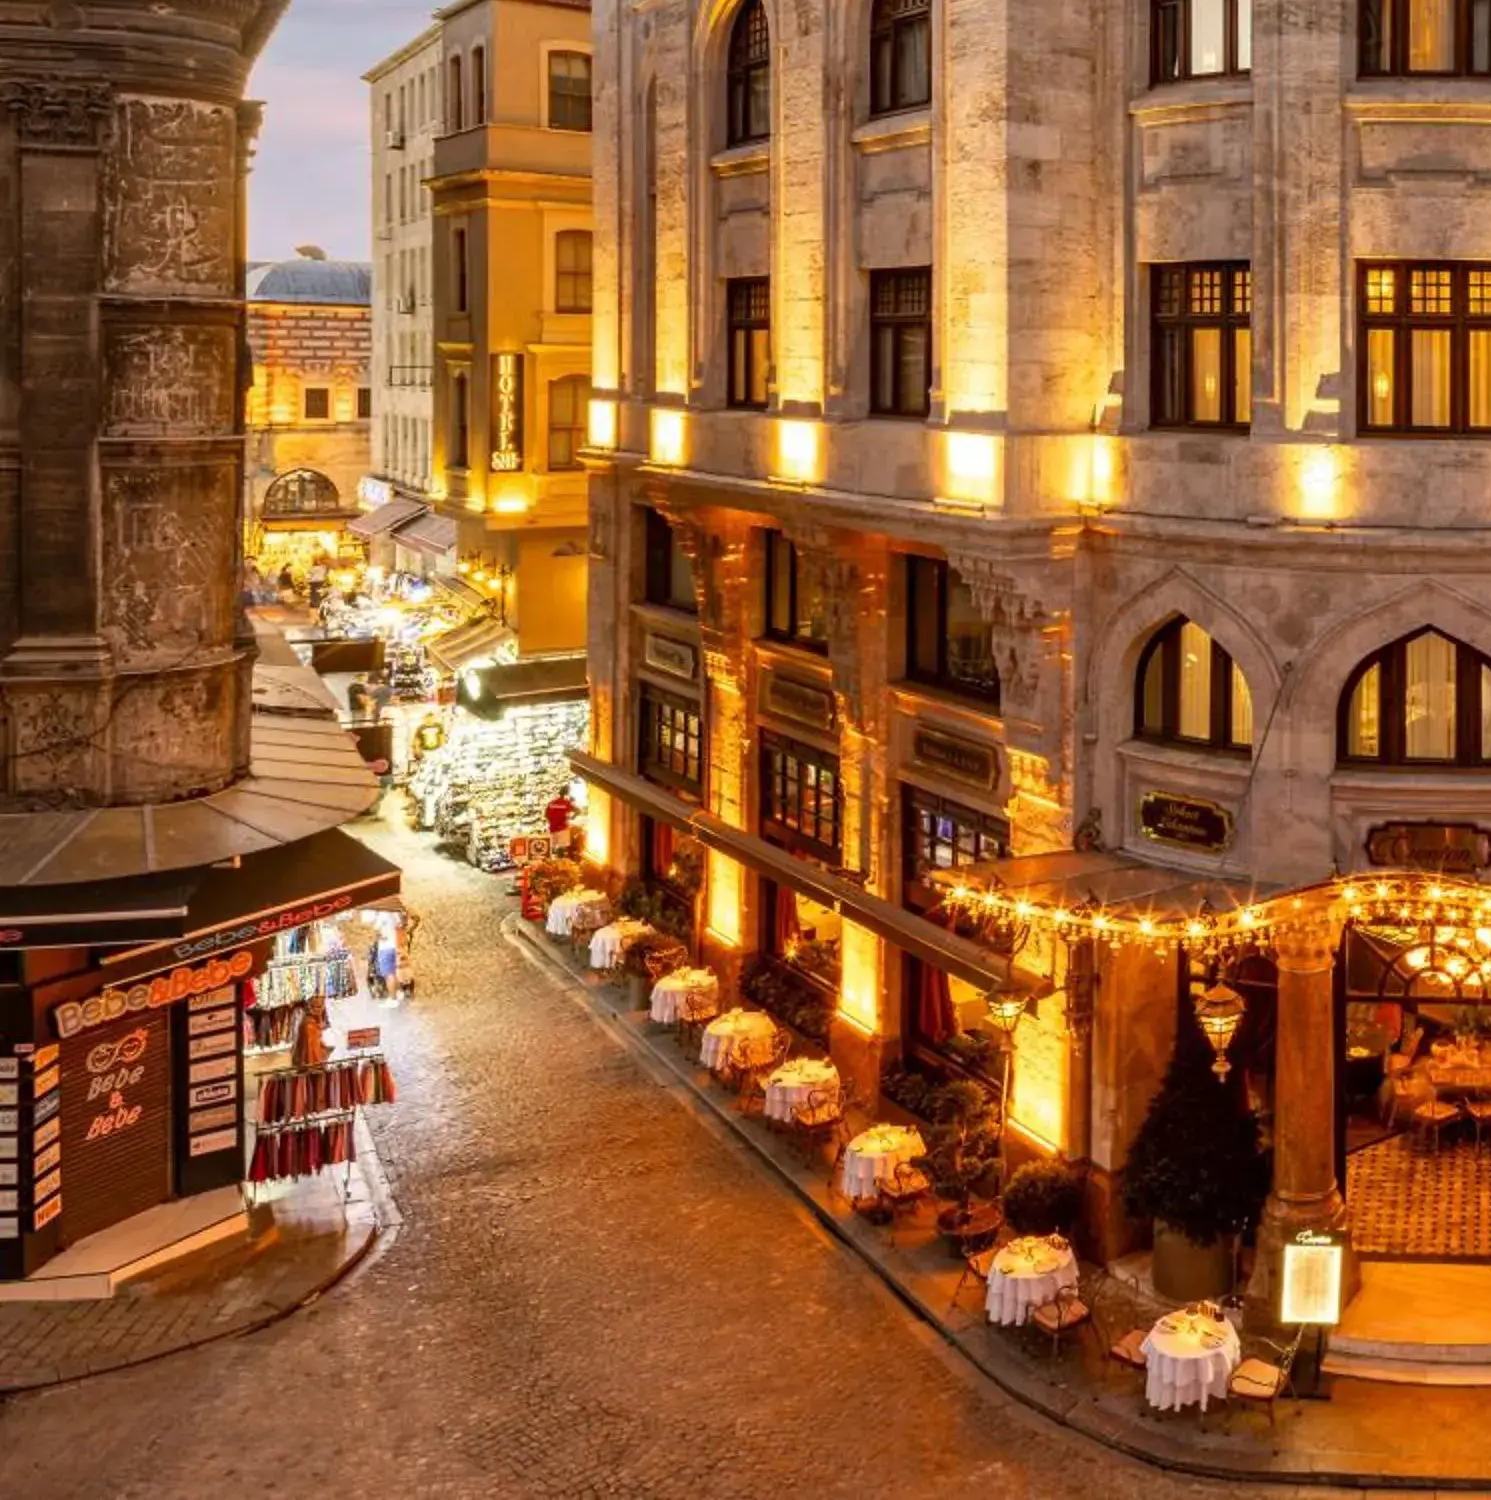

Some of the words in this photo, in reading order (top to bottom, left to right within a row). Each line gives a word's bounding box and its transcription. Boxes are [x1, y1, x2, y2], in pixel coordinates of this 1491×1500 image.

[498, 354, 515, 451] HOTEL
[173, 895, 353, 959] Bebe&Bebe
[54, 951, 253, 1040] Bebe&Bebe
